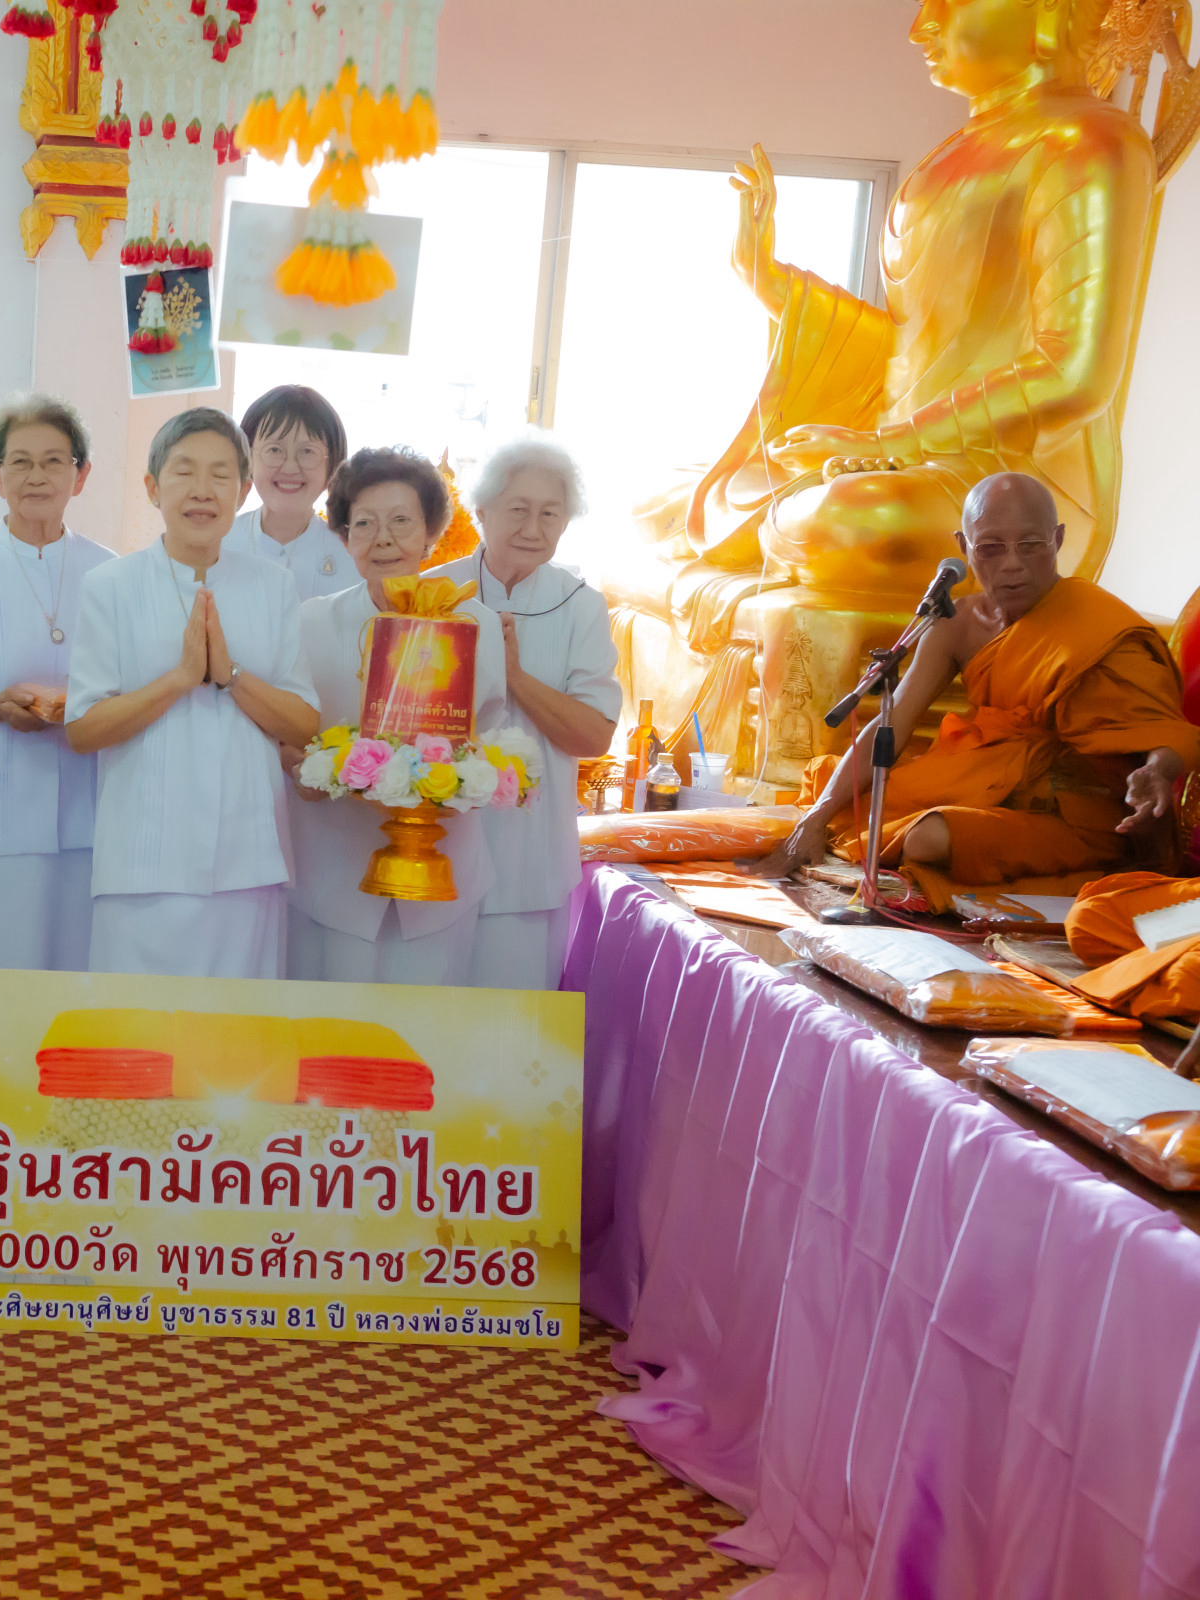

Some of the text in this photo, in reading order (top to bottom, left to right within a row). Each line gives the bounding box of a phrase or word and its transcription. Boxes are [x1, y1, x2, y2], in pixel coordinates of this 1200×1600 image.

[157, 1232, 405, 1291] พุทธศักราช
[423, 1248, 536, 1288] 2568
[161, 1305, 275, 1331] บูชาธรรม
[287, 1307, 316, 1328] 81
[327, 1303, 345, 1328] ปี
[356, 1307, 560, 1337] หลวงพ่อธัมมชโย
